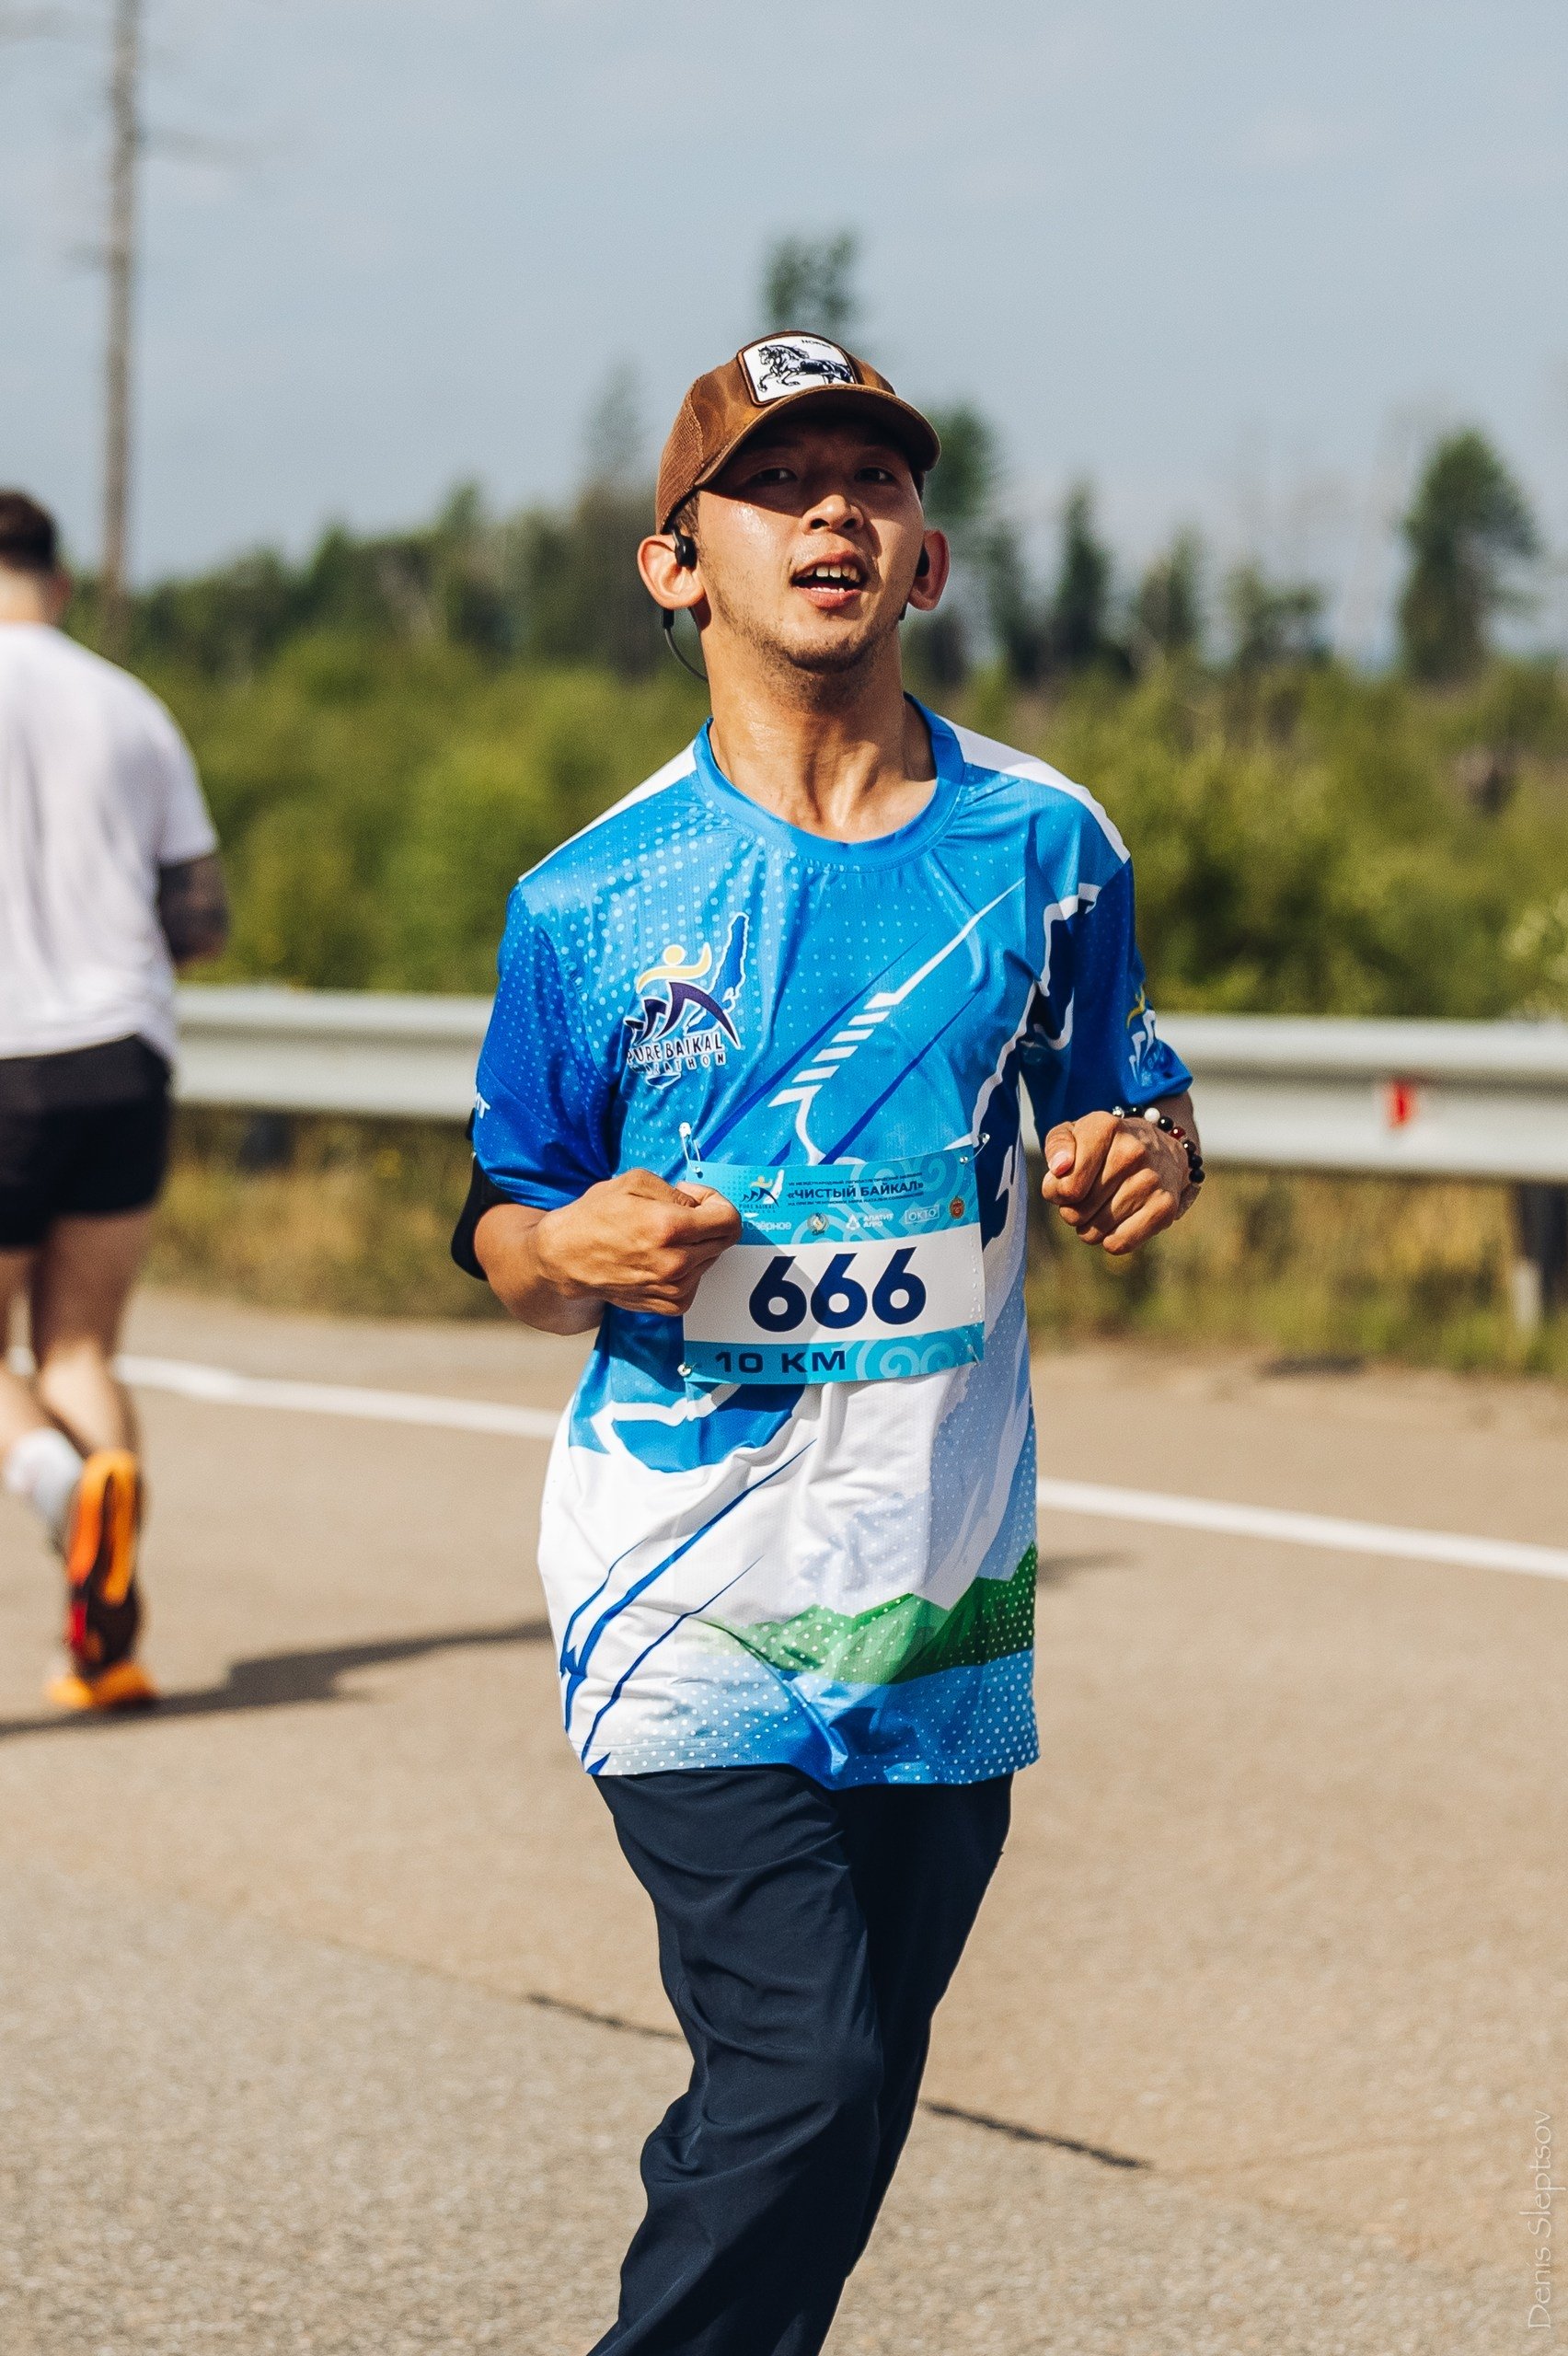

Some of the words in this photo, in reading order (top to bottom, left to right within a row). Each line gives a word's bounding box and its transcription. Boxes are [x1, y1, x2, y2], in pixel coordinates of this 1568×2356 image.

[627, 1044, 662, 1064] PURE
[664, 1033, 723, 1059] BAIKAL
[787, 1185, 856, 1199] «ЧИСТЫЙ
[860, 1181, 924, 1196] БАЙКАЛ»
[748, 1246, 927, 1333] 666
[716, 1350, 764, 1373] 10
